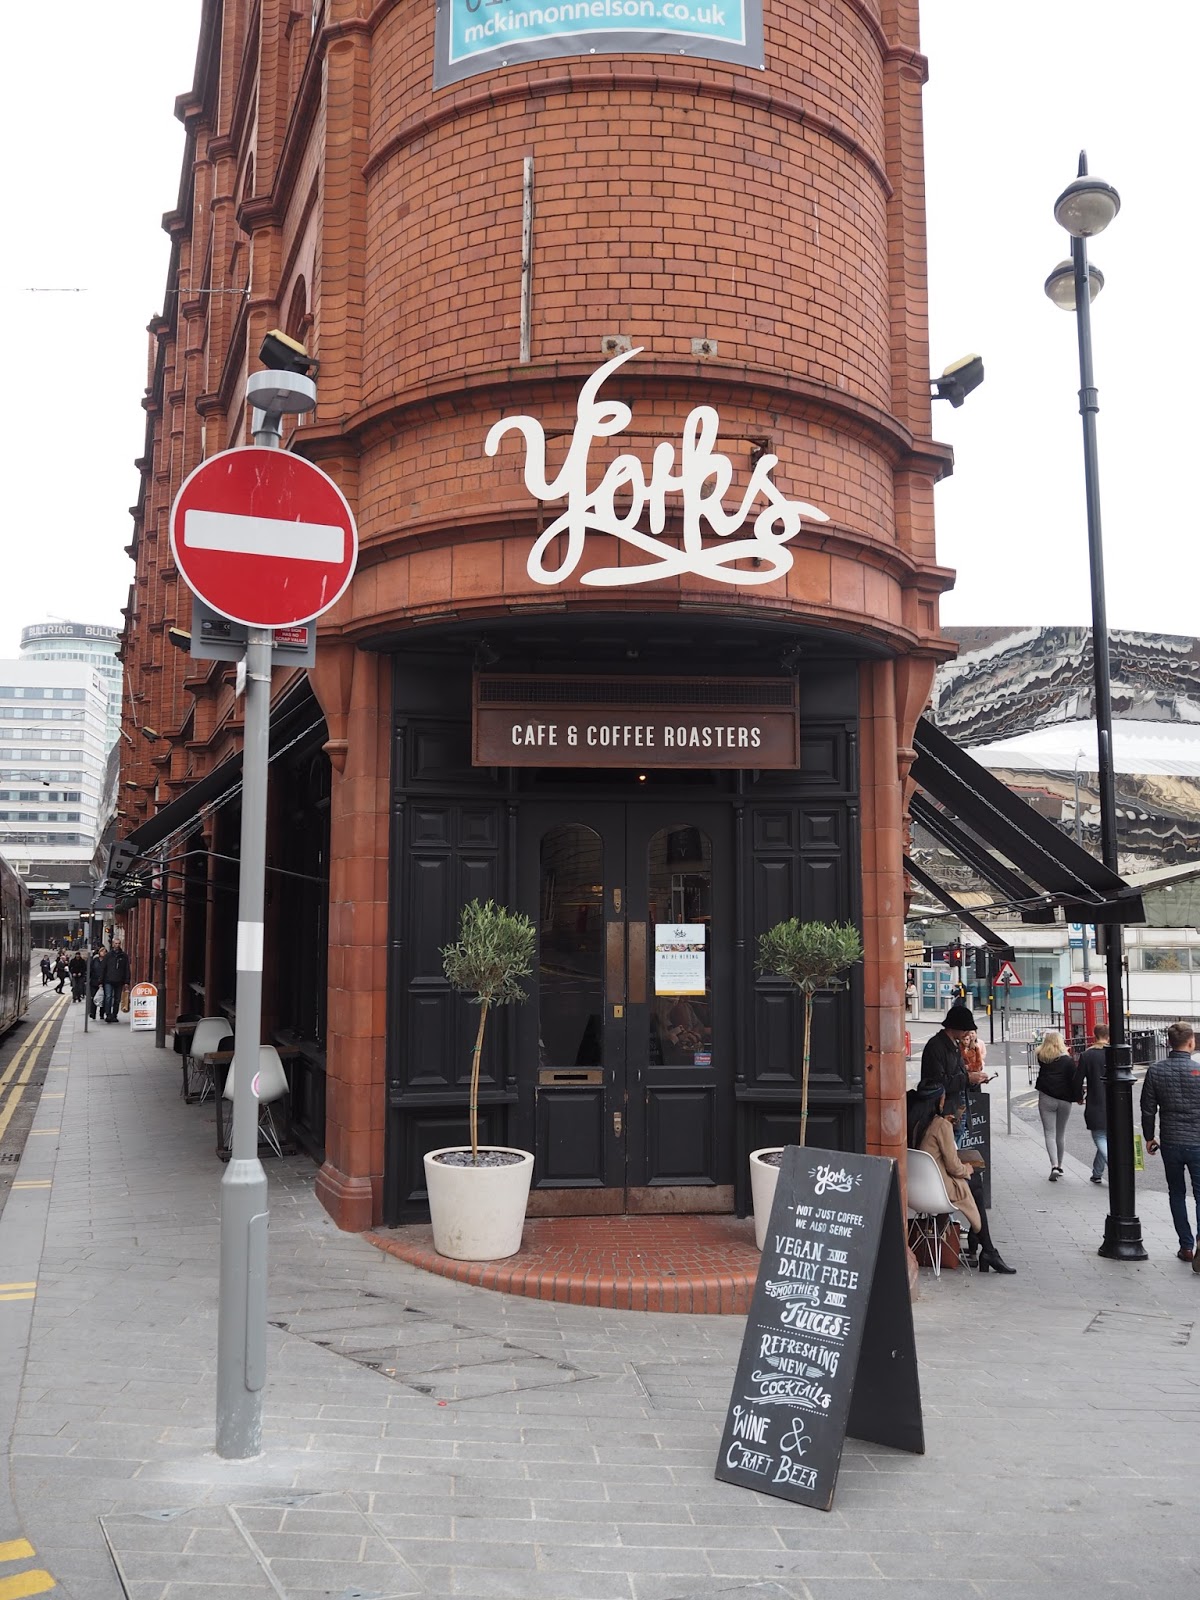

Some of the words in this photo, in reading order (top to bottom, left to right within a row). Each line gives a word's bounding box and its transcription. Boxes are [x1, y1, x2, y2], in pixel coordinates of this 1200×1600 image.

[464, 0, 726, 43] mckinnonnelson.co.uk
[485, 346, 831, 586] Yorks
[29, 625, 73, 637] BULLRING
[512, 724, 557, 745] CAFE
[567, 725, 577, 746] &
[587, 725, 654, 747] COFFEE
[664, 726, 761, 748] ROASTERS
[137, 987, 153, 995] OPEN
[962, 1136, 985, 1148] LOCAL
[814, 1164, 853, 1195] Yorks
[796, 1204, 814, 1216] NOT
[815, 1208, 836, 1221] JUST
[795, 1218, 807, 1230] WE
[809, 1220, 828, 1233] ALSO
[829, 1223, 853, 1238] SERVE
[775, 1235, 824, 1262] VEGAN
[826, 1249, 848, 1264] AND
[778, 1257, 819, 1282] DAIRY
[820, 1265, 859, 1290] FREE
[823, 1291, 847, 1308] AND
[778, 1357, 807, 1377] NEW
[780, 1417, 812, 1457] &
